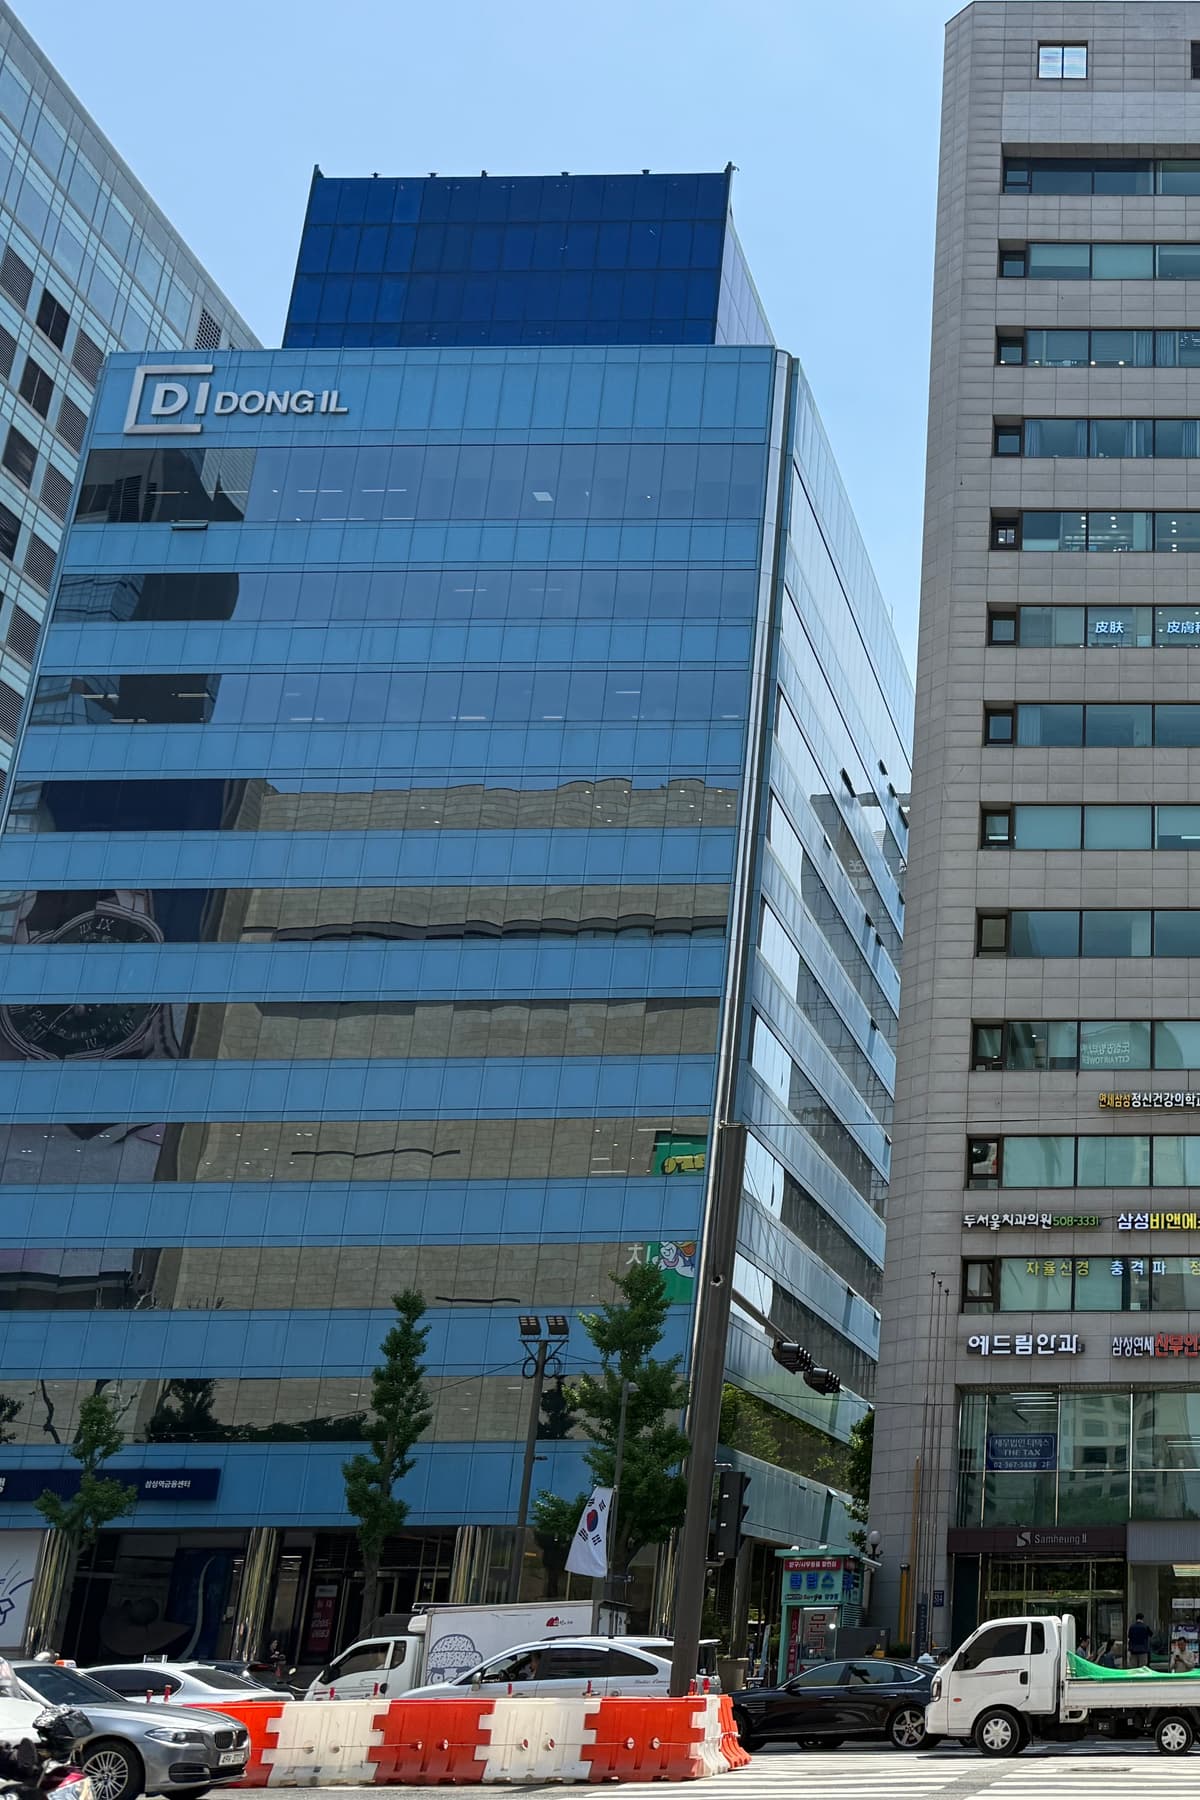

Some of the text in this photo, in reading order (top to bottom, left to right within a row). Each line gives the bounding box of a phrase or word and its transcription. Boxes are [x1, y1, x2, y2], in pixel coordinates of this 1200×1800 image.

[214, 390, 348, 415] DONGIL
[1095, 621, 1124, 634] 皮肤
[963, 1213, 1100, 1230] 두서울치과의원 508-3331
[1026, 1261, 1090, 1276] 자율신경
[1110, 1260, 1167, 1276] 충격파
[968, 1334, 1079, 1356] 예드림안과
[145, 1480, 191, 1489] 삼성역금융센터
[1034, 1534, 1080, 1545] Samheung
